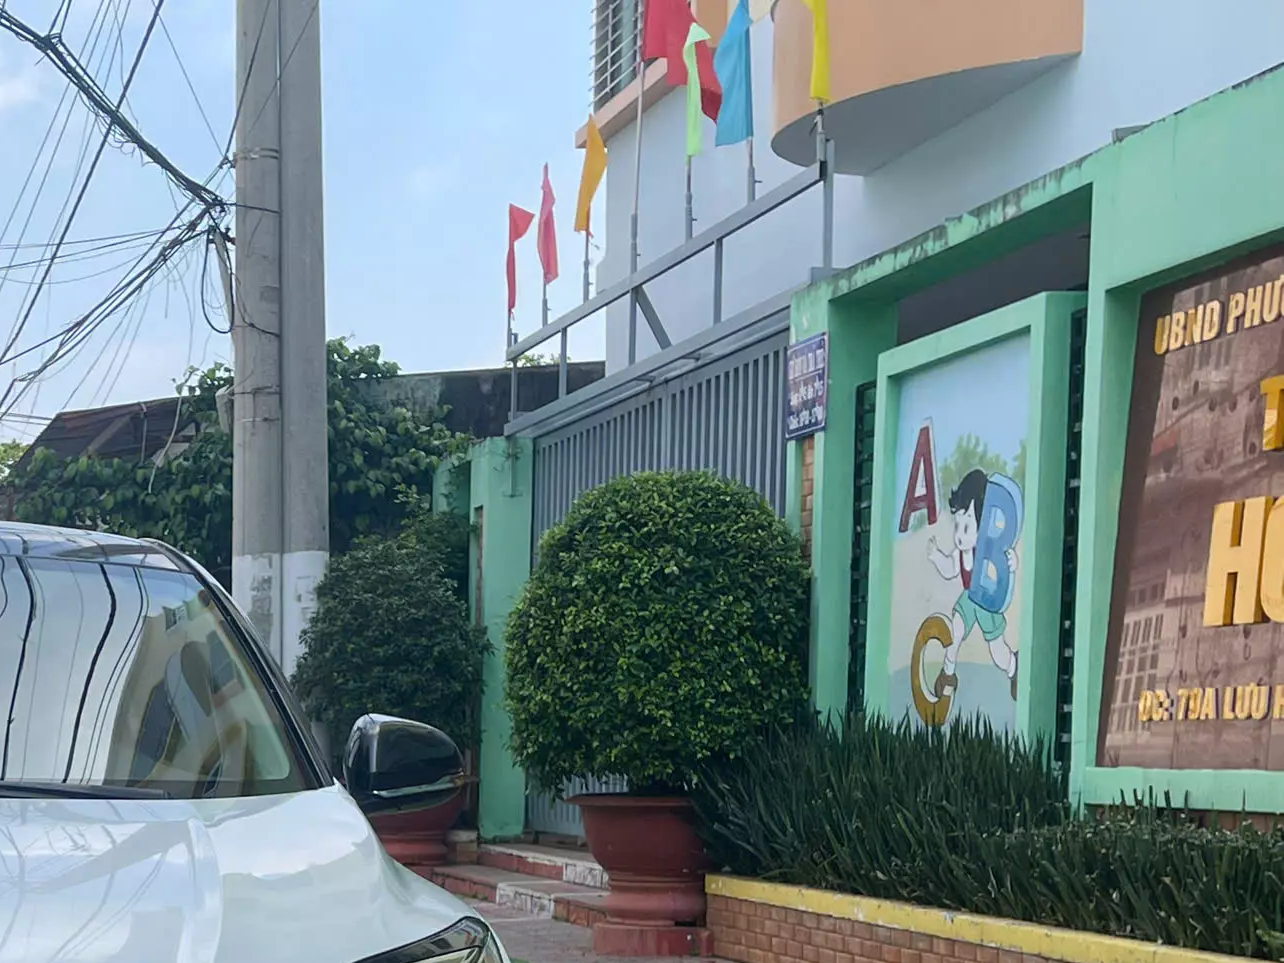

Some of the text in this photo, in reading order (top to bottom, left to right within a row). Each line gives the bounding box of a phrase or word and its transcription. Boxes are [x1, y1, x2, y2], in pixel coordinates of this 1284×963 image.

[1154, 274, 1284, 356] UBND PHƯ
[898, 418, 940, 534] A
